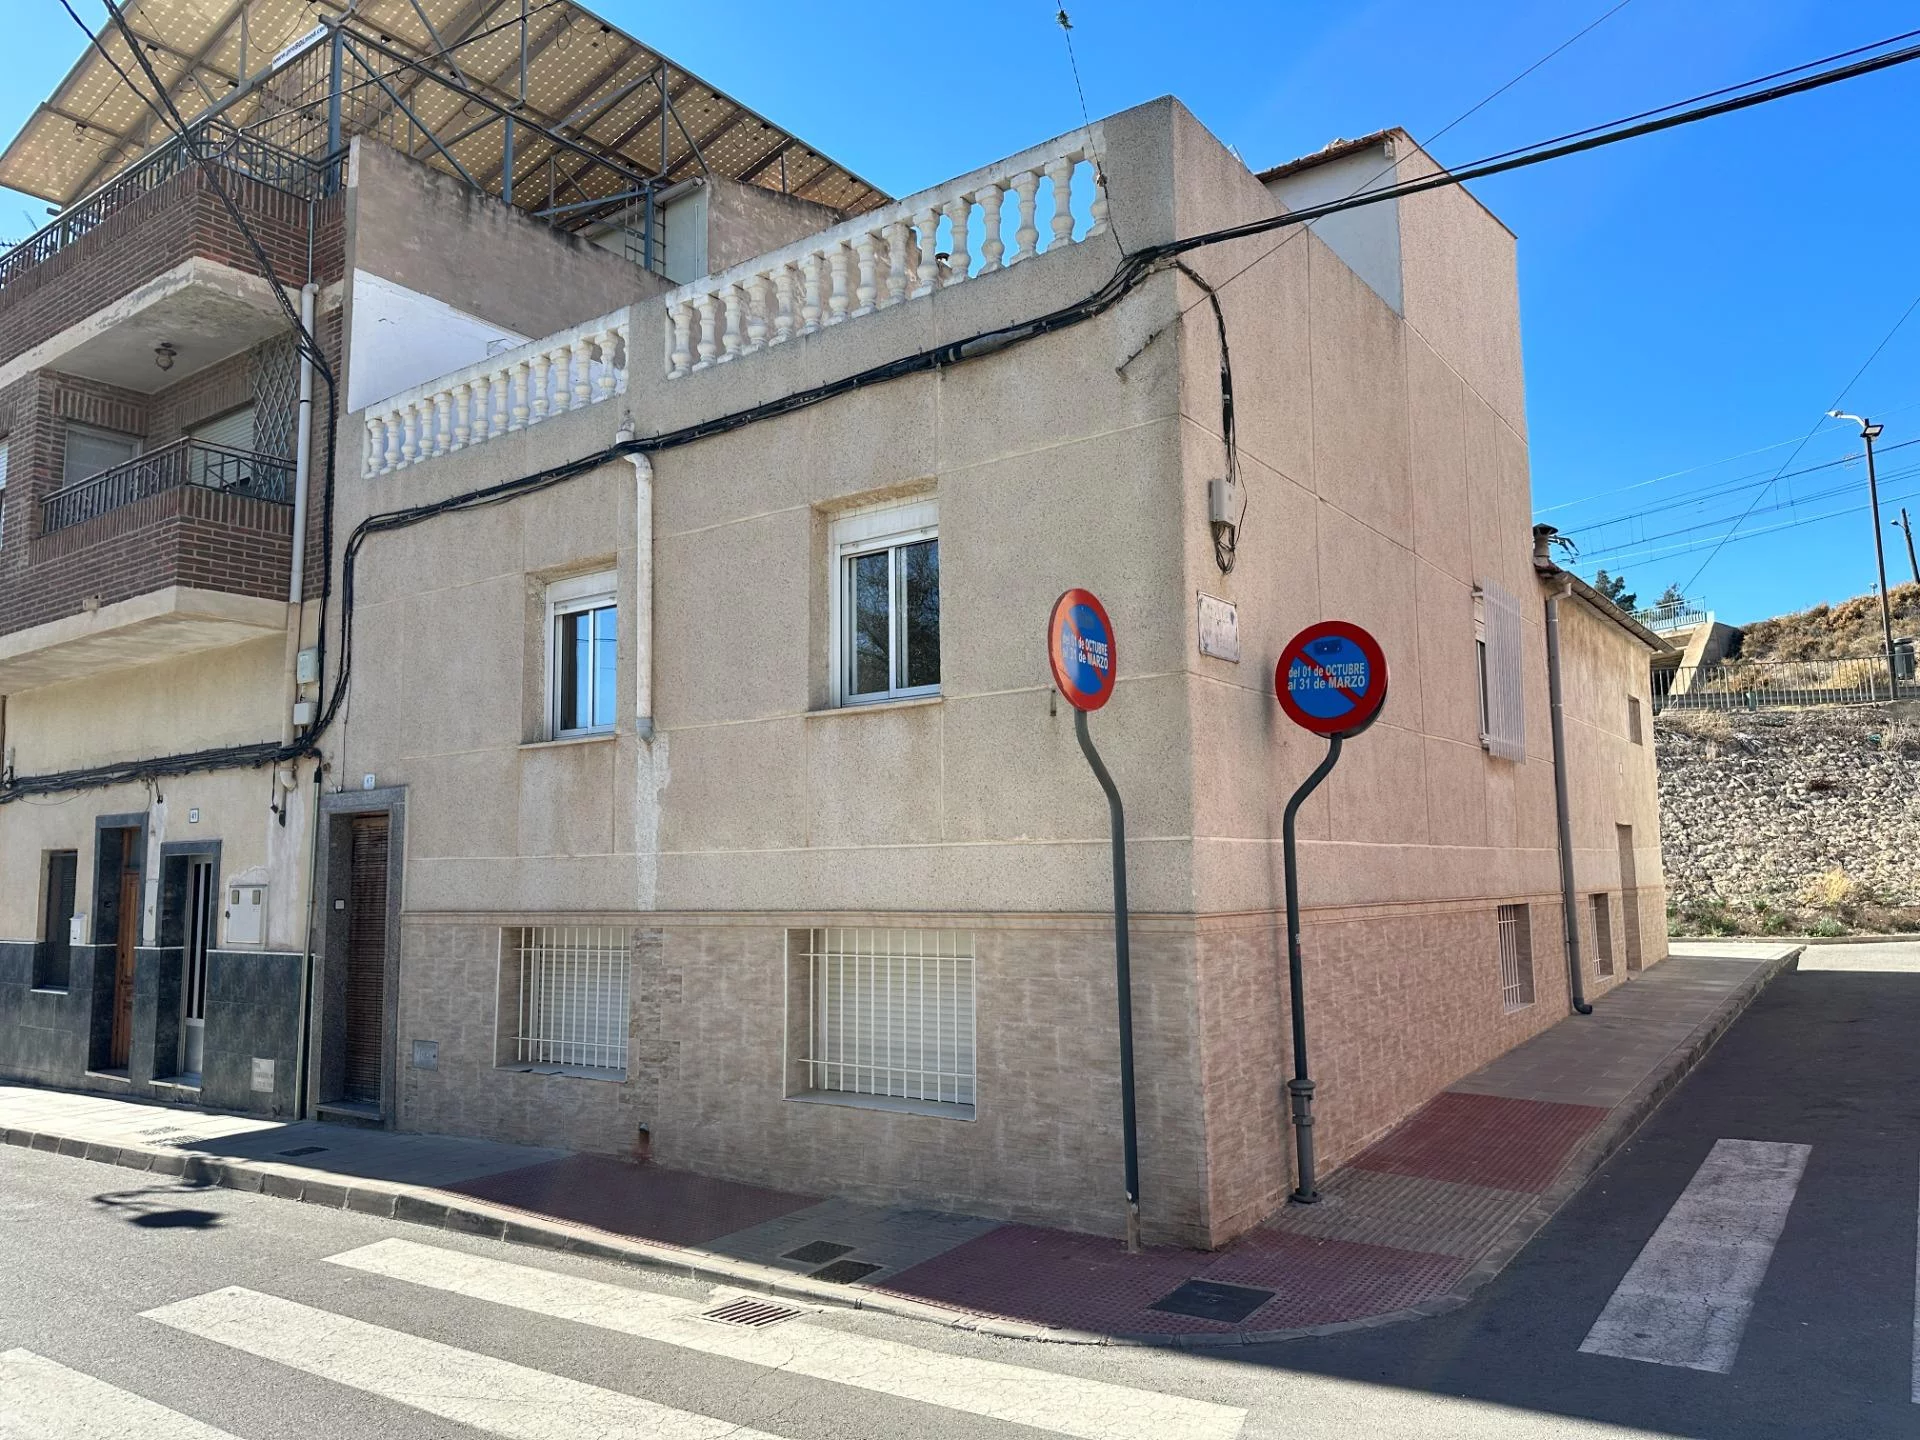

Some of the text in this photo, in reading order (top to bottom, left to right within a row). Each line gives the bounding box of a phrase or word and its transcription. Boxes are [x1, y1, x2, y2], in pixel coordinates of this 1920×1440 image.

[1078, 636, 1085, 650] de
[1085, 638, 1108, 656] OCTUBRE
[1078, 650, 1087, 664] de
[1087, 652, 1109, 669] MARZO
[1288, 662, 1365, 678] del 01 de OCTUBRE
[1287, 675, 1366, 691] al 31 de MARZO
